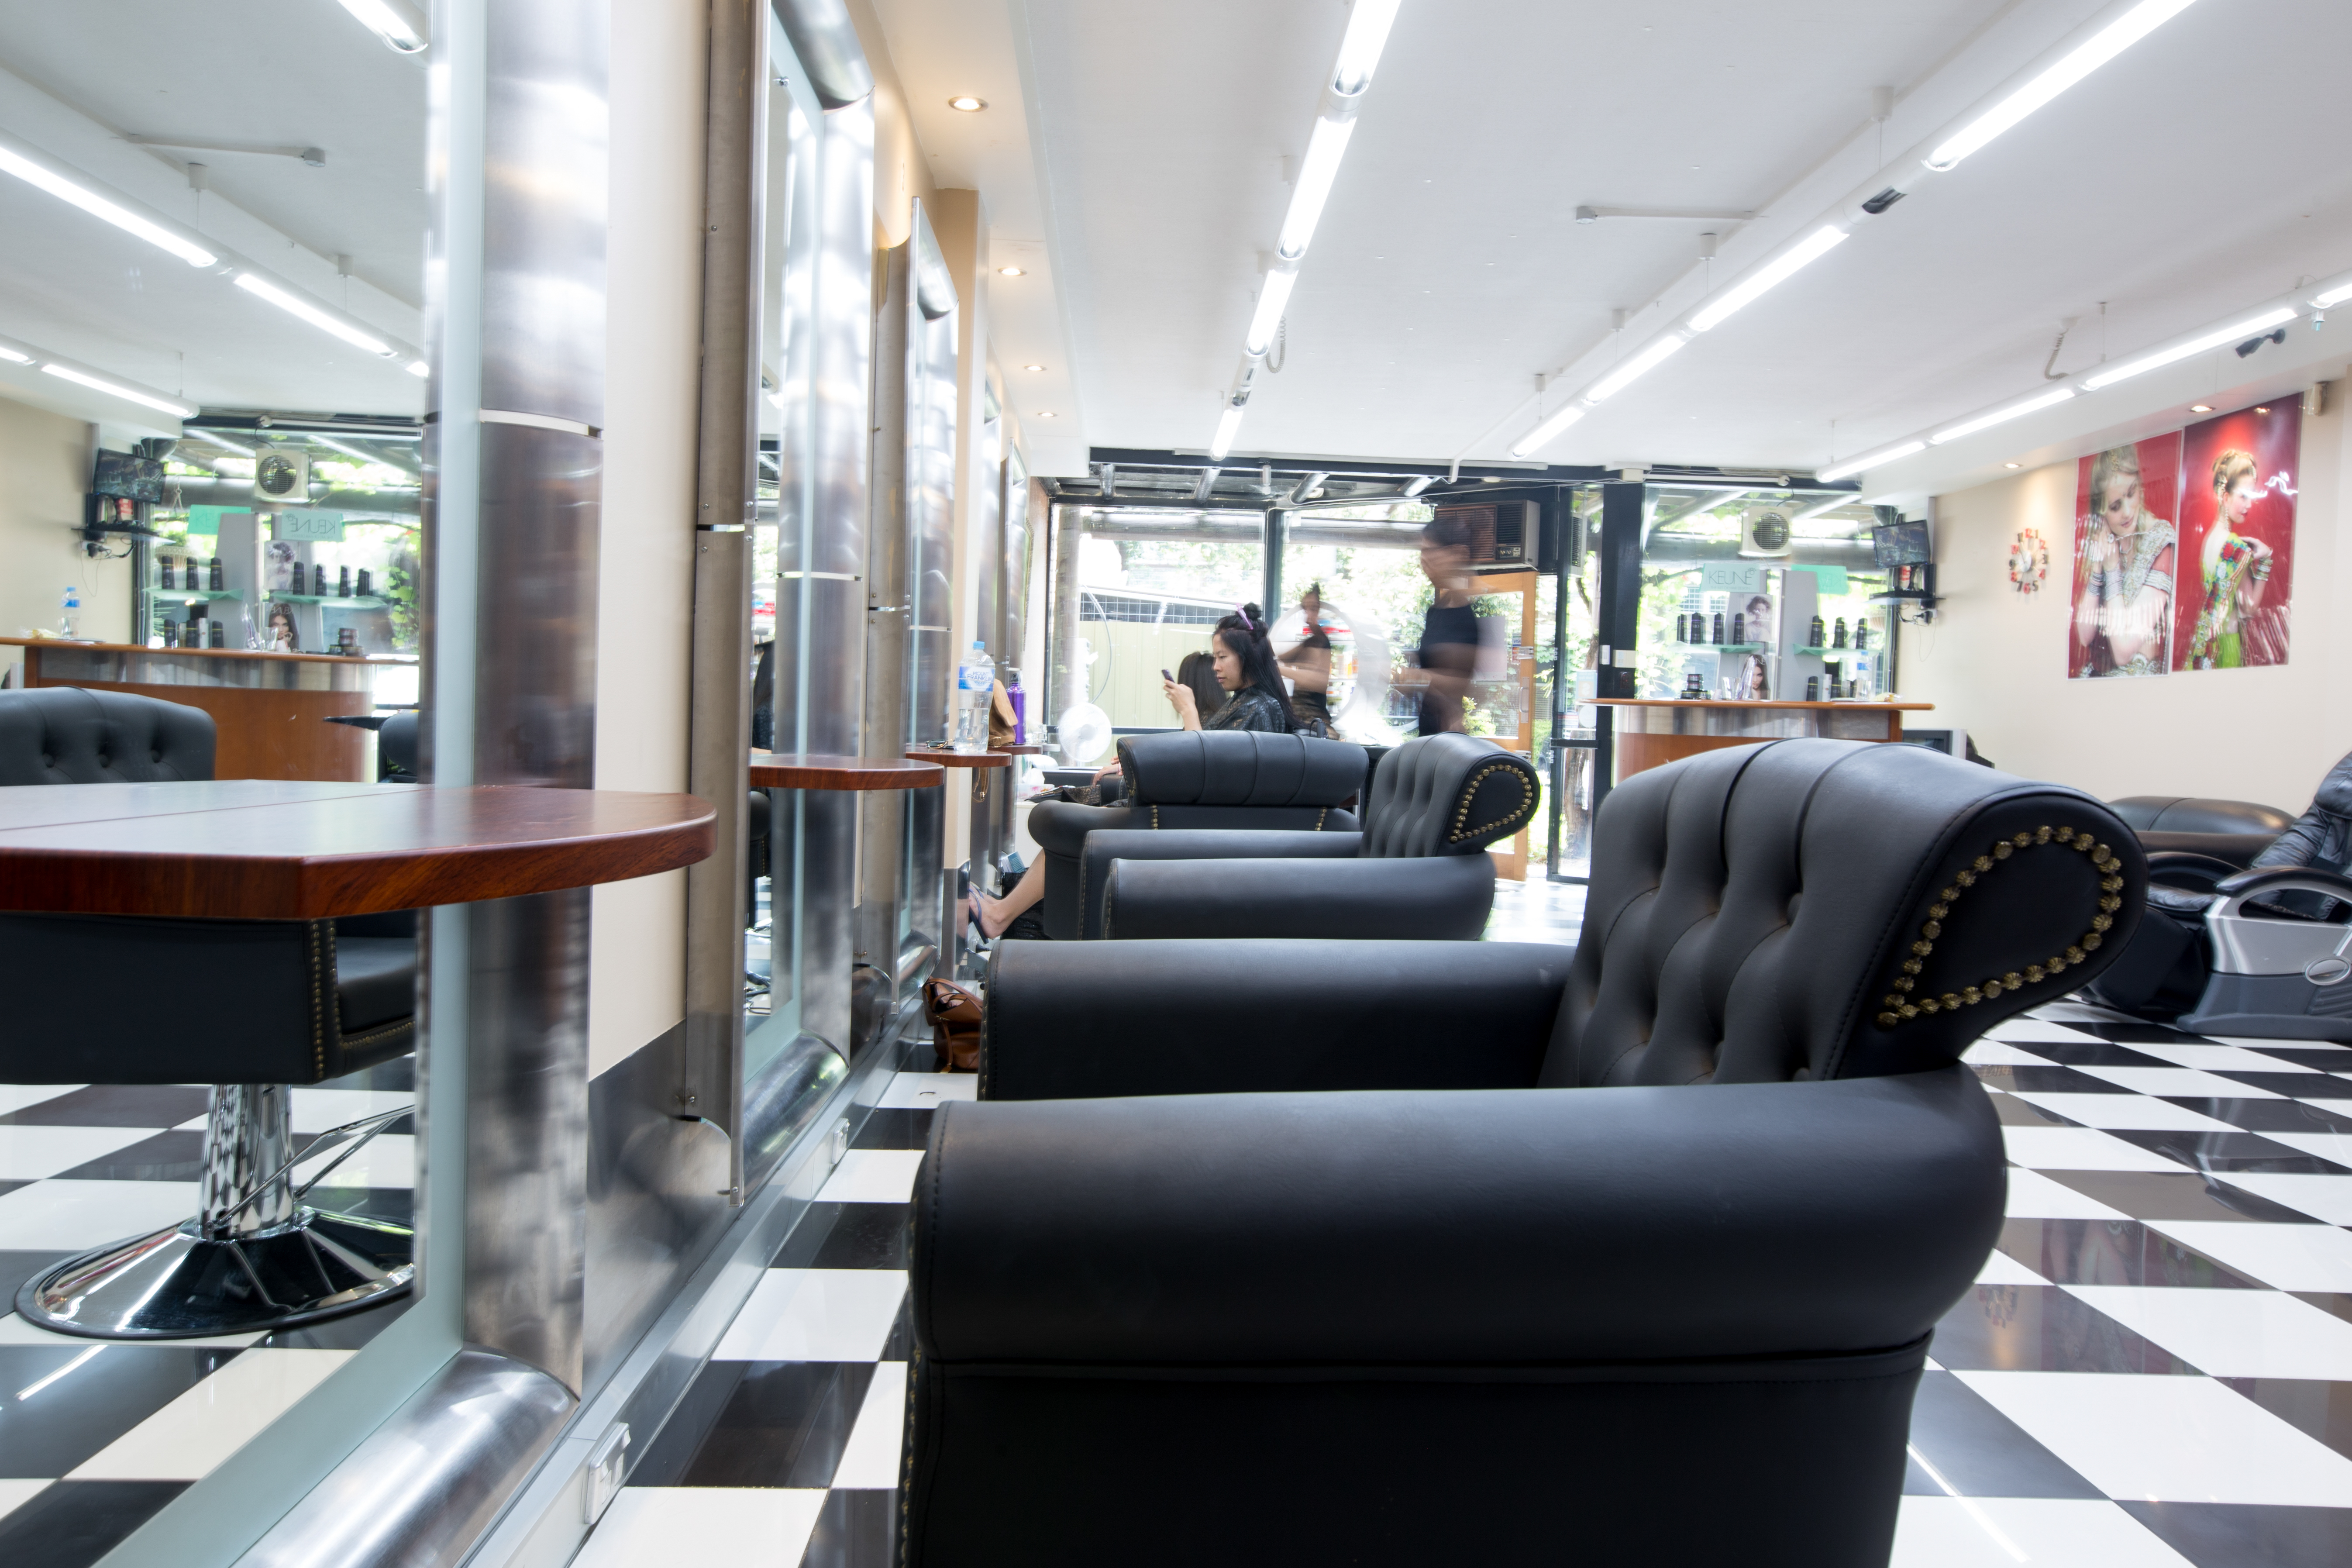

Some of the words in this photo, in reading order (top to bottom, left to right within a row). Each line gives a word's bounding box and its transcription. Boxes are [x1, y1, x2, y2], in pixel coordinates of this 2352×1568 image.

[2039, 539, 2046, 549] 2
[2009, 559, 2015, 570] 9
[2042, 554, 2048, 564] 3
[1709, 570, 1752, 585] KEUNE
[2011, 572, 2017, 582] 8
[2039, 569, 2046, 580] 4
[2017, 581, 2022, 592] 7
[2023, 582, 2030, 594] 6
[2032, 580, 2039, 591] 5
